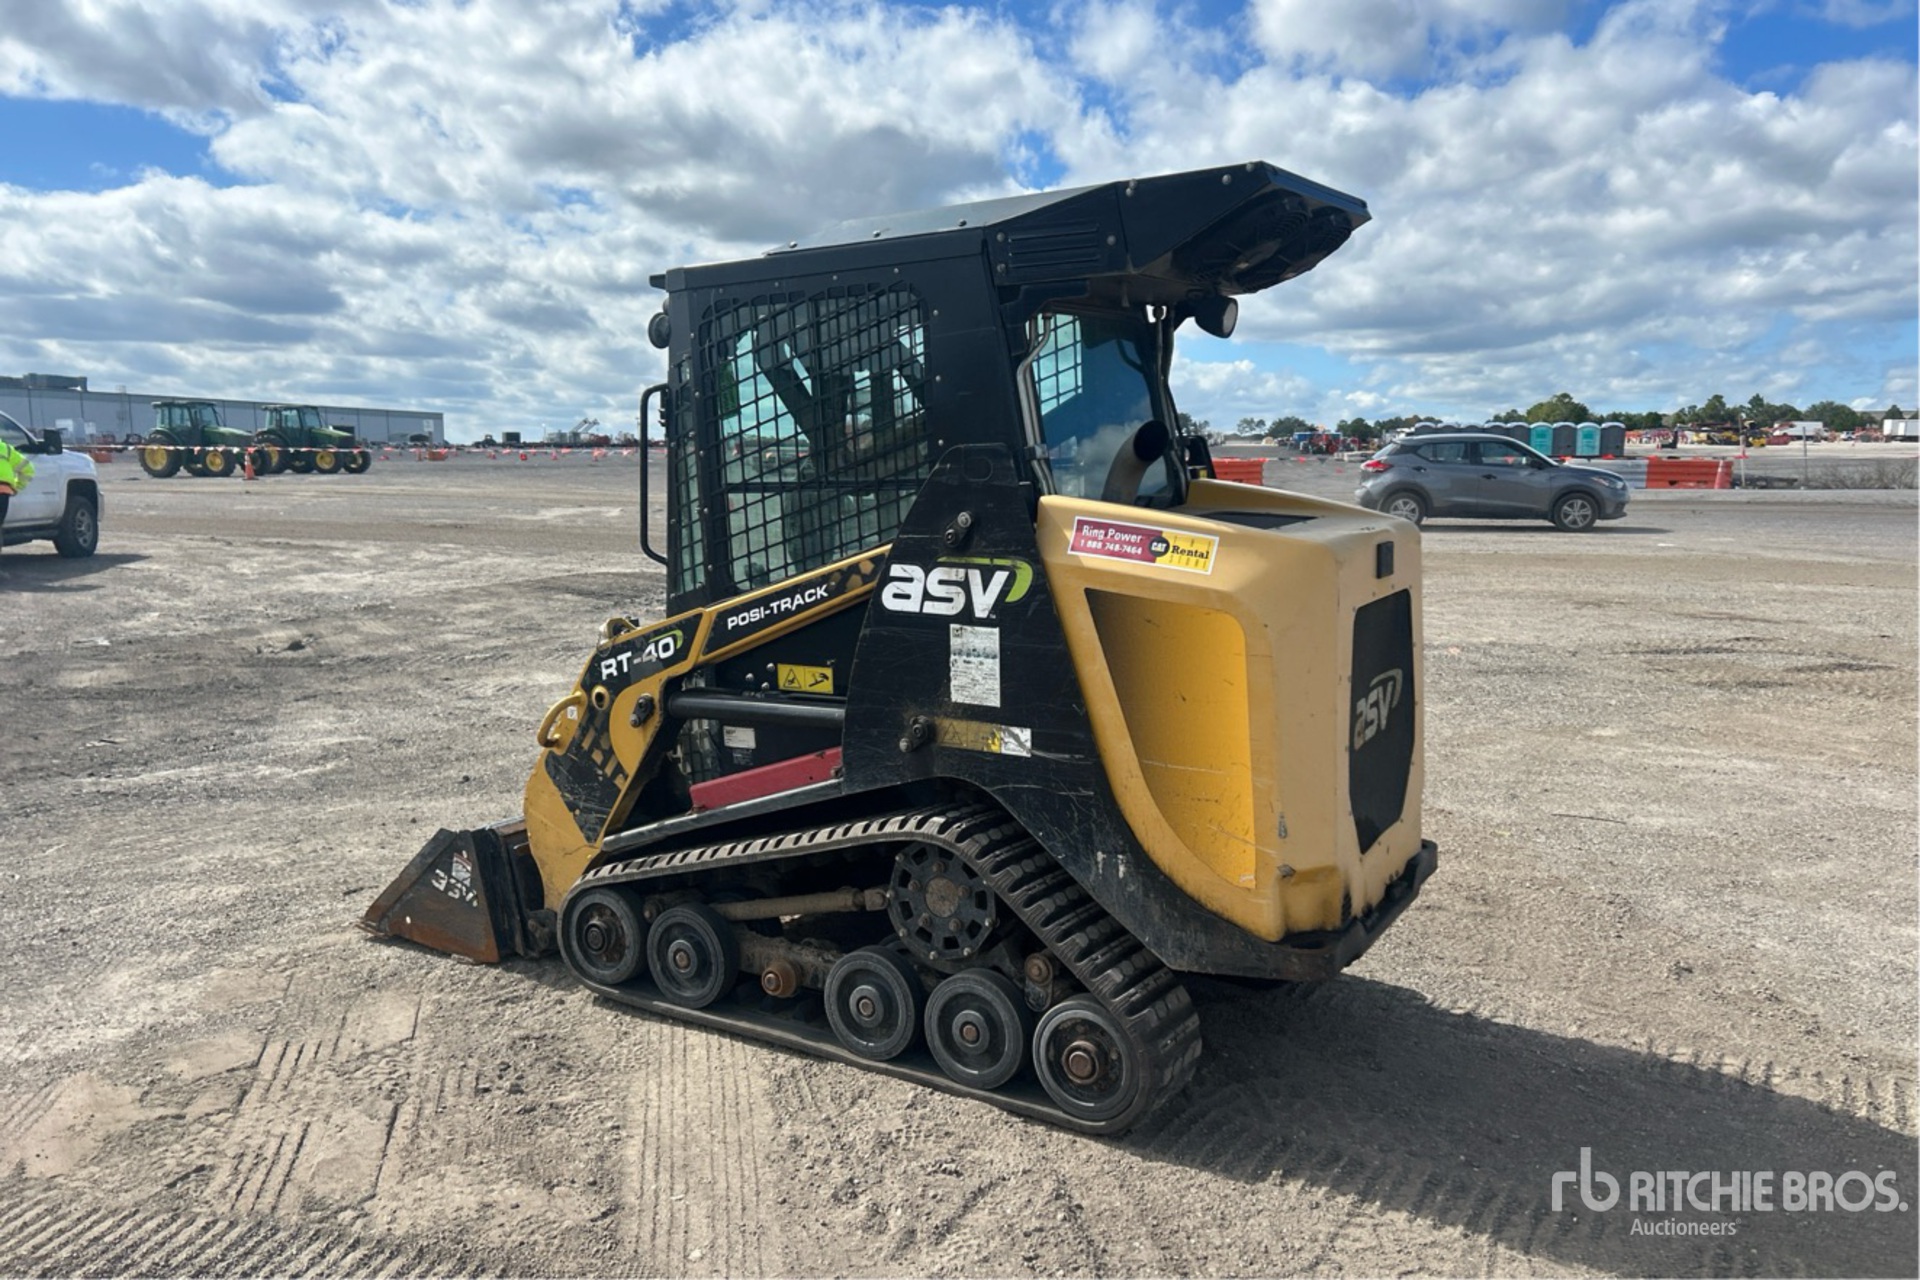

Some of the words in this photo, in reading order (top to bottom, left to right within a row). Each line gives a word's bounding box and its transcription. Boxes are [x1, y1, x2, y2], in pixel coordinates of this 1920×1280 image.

[1082, 525, 1105, 541] Ring
[1107, 528, 1142, 543] Power
[1151, 542, 1167, 552] CAT
[1171, 545, 1210, 560] Rental
[727, 584, 829, 630] POSI-TRACK
[600, 636, 675, 681] RT-40
